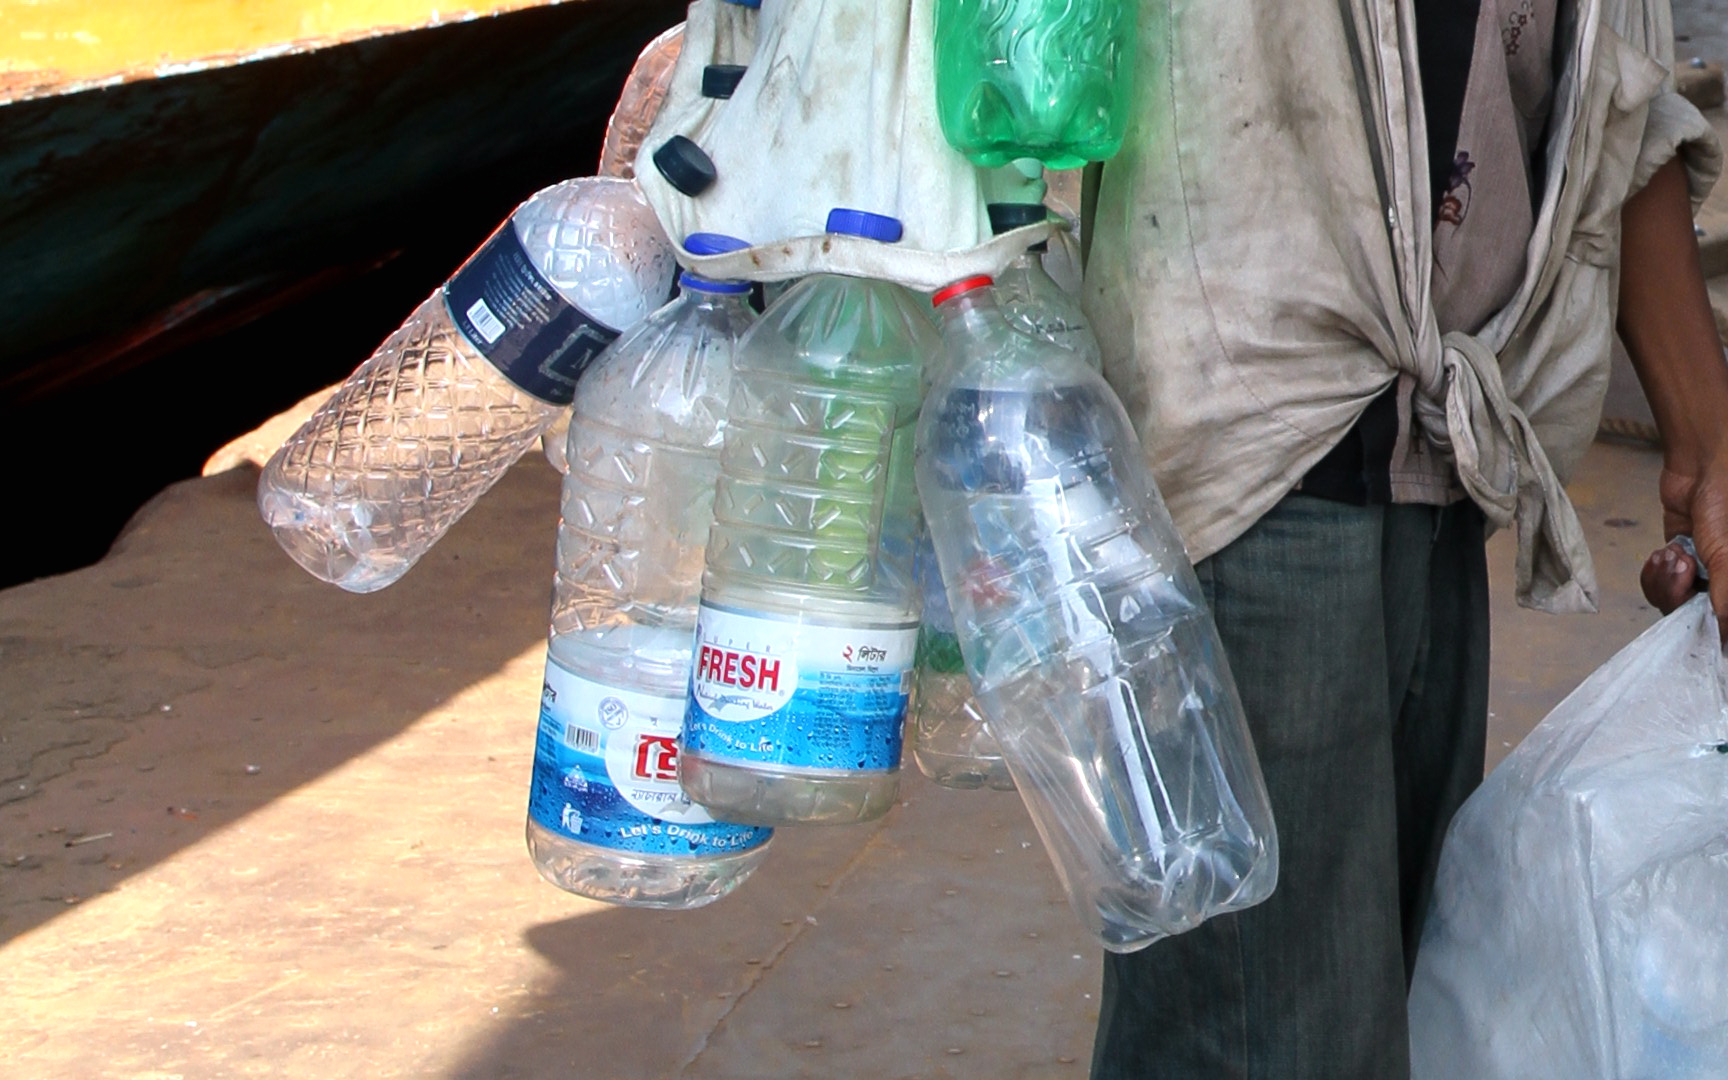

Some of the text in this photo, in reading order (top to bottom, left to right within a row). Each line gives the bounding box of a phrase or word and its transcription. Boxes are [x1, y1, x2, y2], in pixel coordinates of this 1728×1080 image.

[843, 645, 888, 663] ২ লিটার
[698, 645, 781, 692] FRESH
[708, 723, 733, 743] Drink
[735, 739, 747, 750] to
[620, 823, 754, 848] Let's Drink to Life
